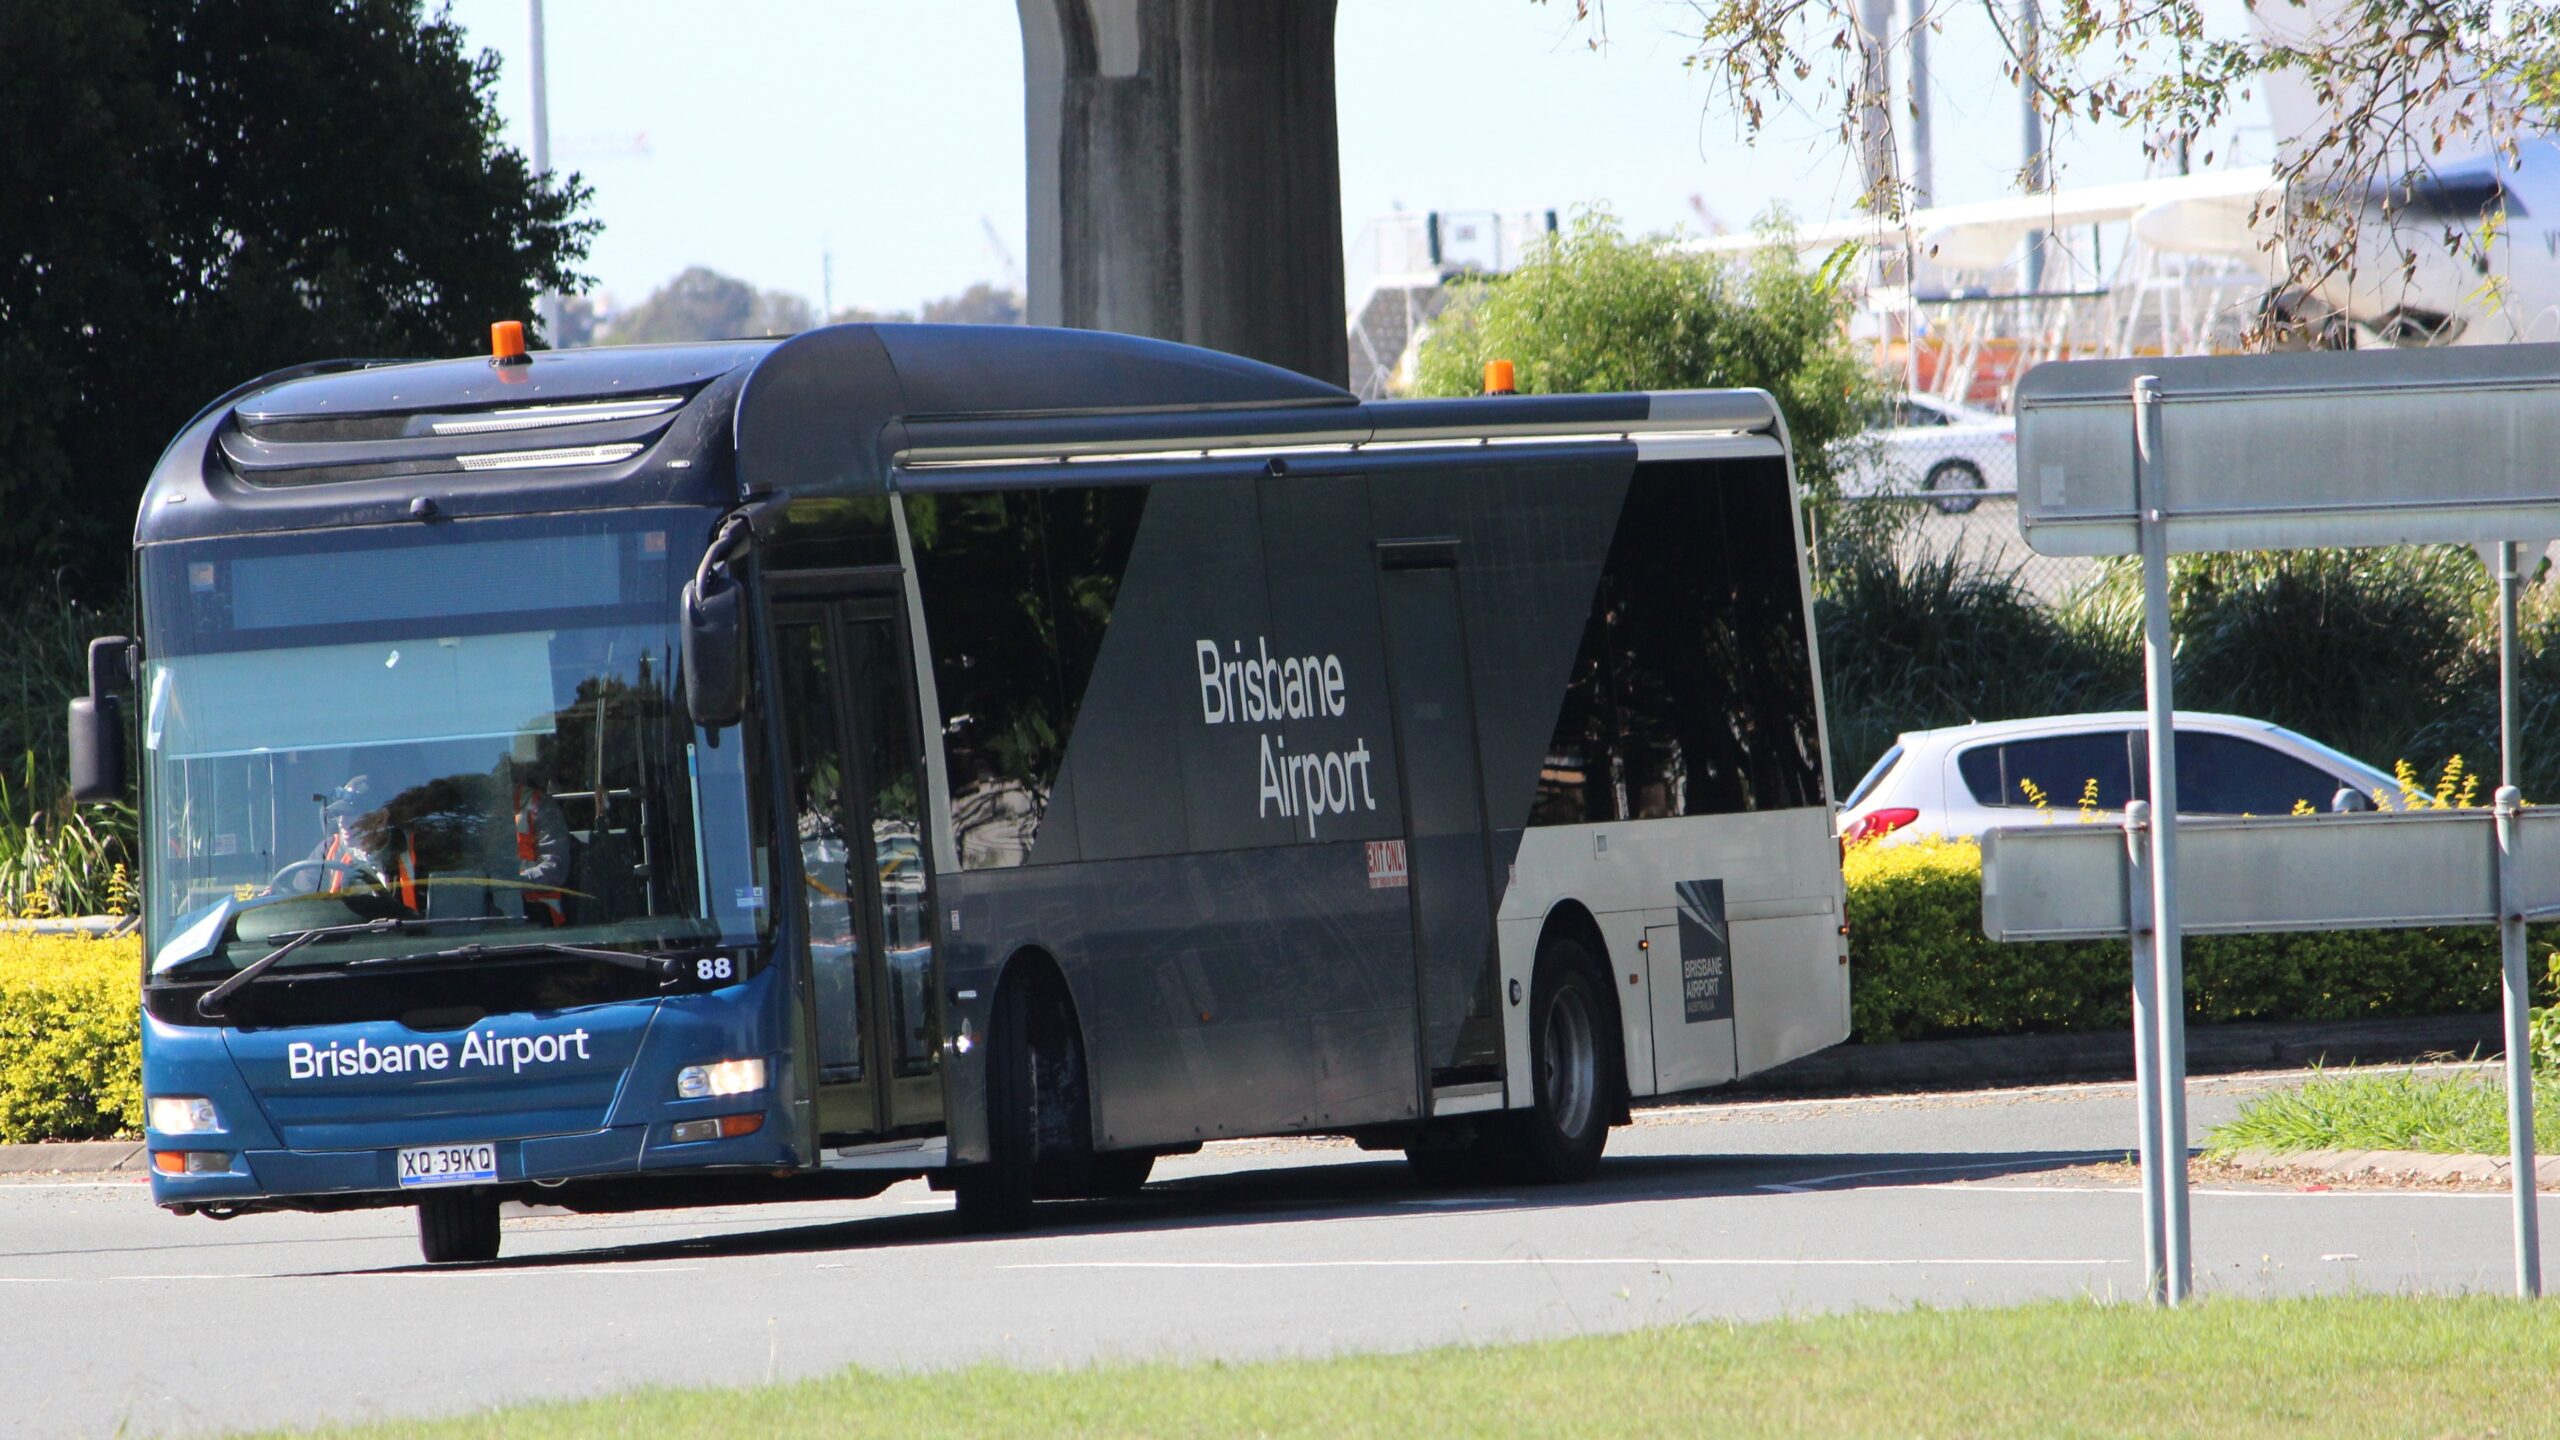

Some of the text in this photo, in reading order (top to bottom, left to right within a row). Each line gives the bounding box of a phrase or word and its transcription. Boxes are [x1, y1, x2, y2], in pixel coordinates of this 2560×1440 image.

[1196, 636, 1345, 724] Brisbane
[1260, 734, 1376, 838] Airport
[1366, 841, 1406, 873] EXIT ONLY
[697, 957, 732, 980] 88
[1684, 957, 1723, 979] BRISBANE
[1686, 978, 1719, 999] AIRPORT
[288, 1028, 590, 1079] Brisbane Airport
